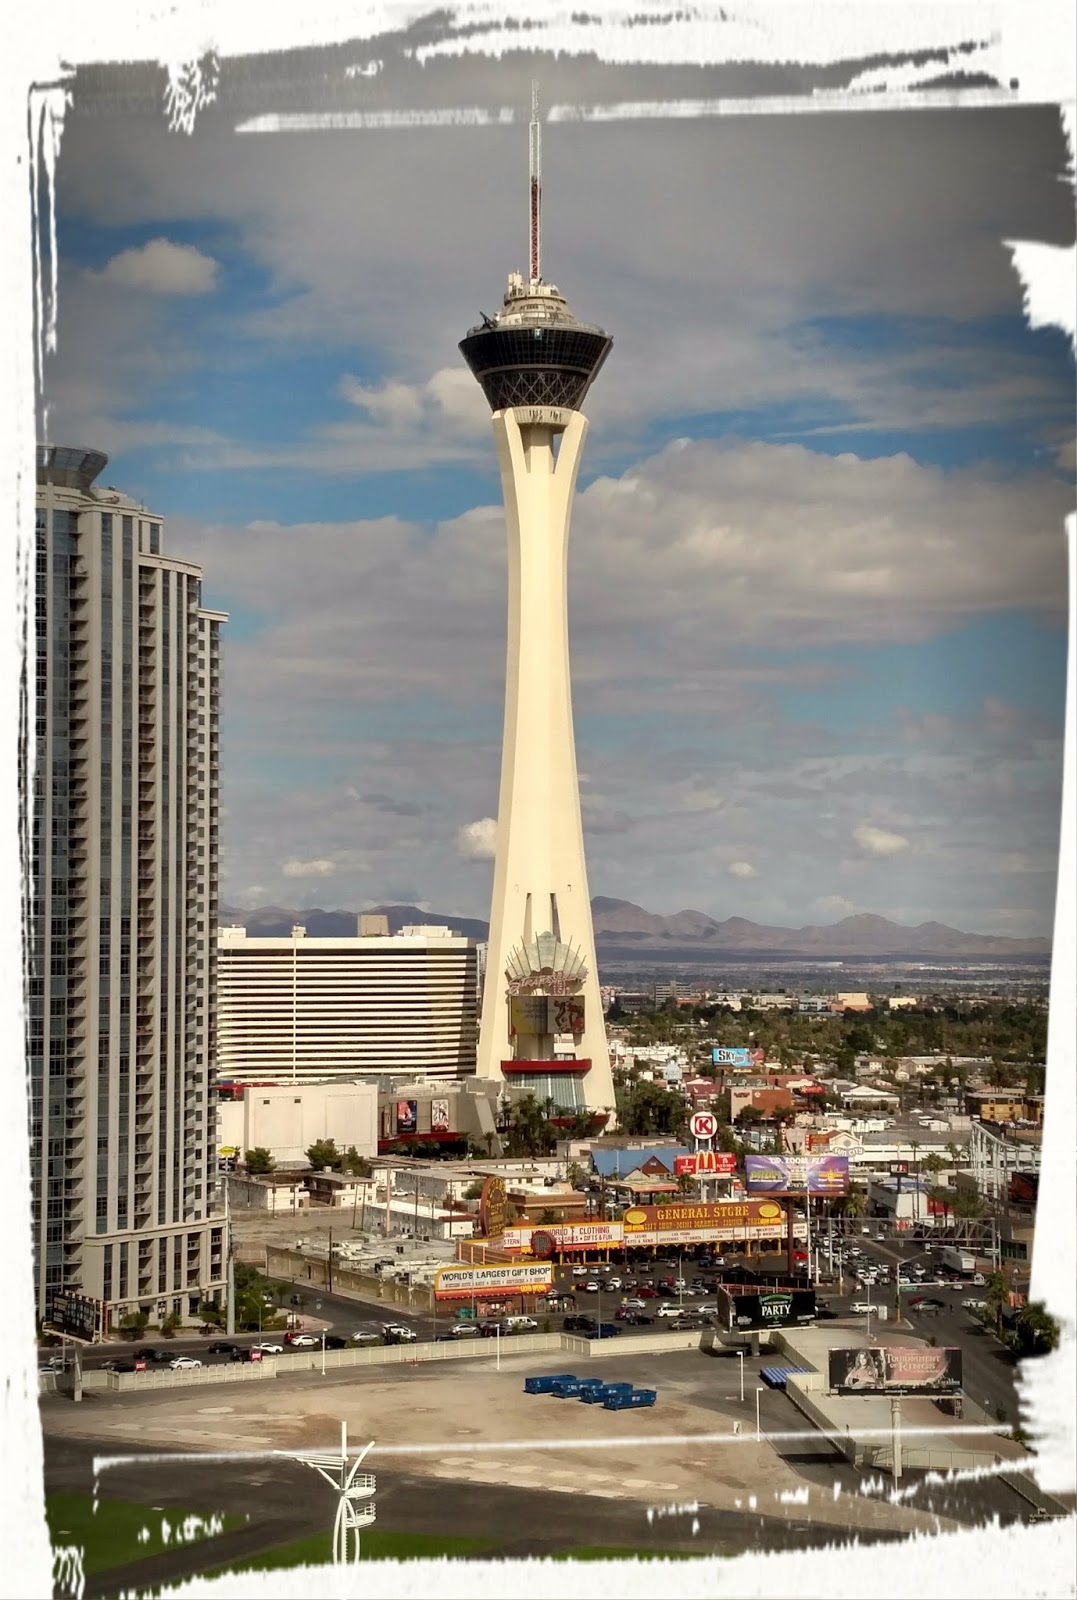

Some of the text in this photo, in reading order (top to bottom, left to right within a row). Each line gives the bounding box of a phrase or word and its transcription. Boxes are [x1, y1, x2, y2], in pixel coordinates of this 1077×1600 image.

[835, 1147, 863, 1156] FUN CITY
[657, 1208, 710, 1221] GENERAL
[713, 1205, 750, 1218] STORE
[579, 1226, 610, 1235] CLOTHING
[442, 1267, 550, 1281] WORLD'S LARGEST GIFT SHOP
[761, 1303, 792, 1316] PARTY
[886, 1353, 941, 1364] TOURNAMENT
[898, 1362, 936, 1372] KINGS
